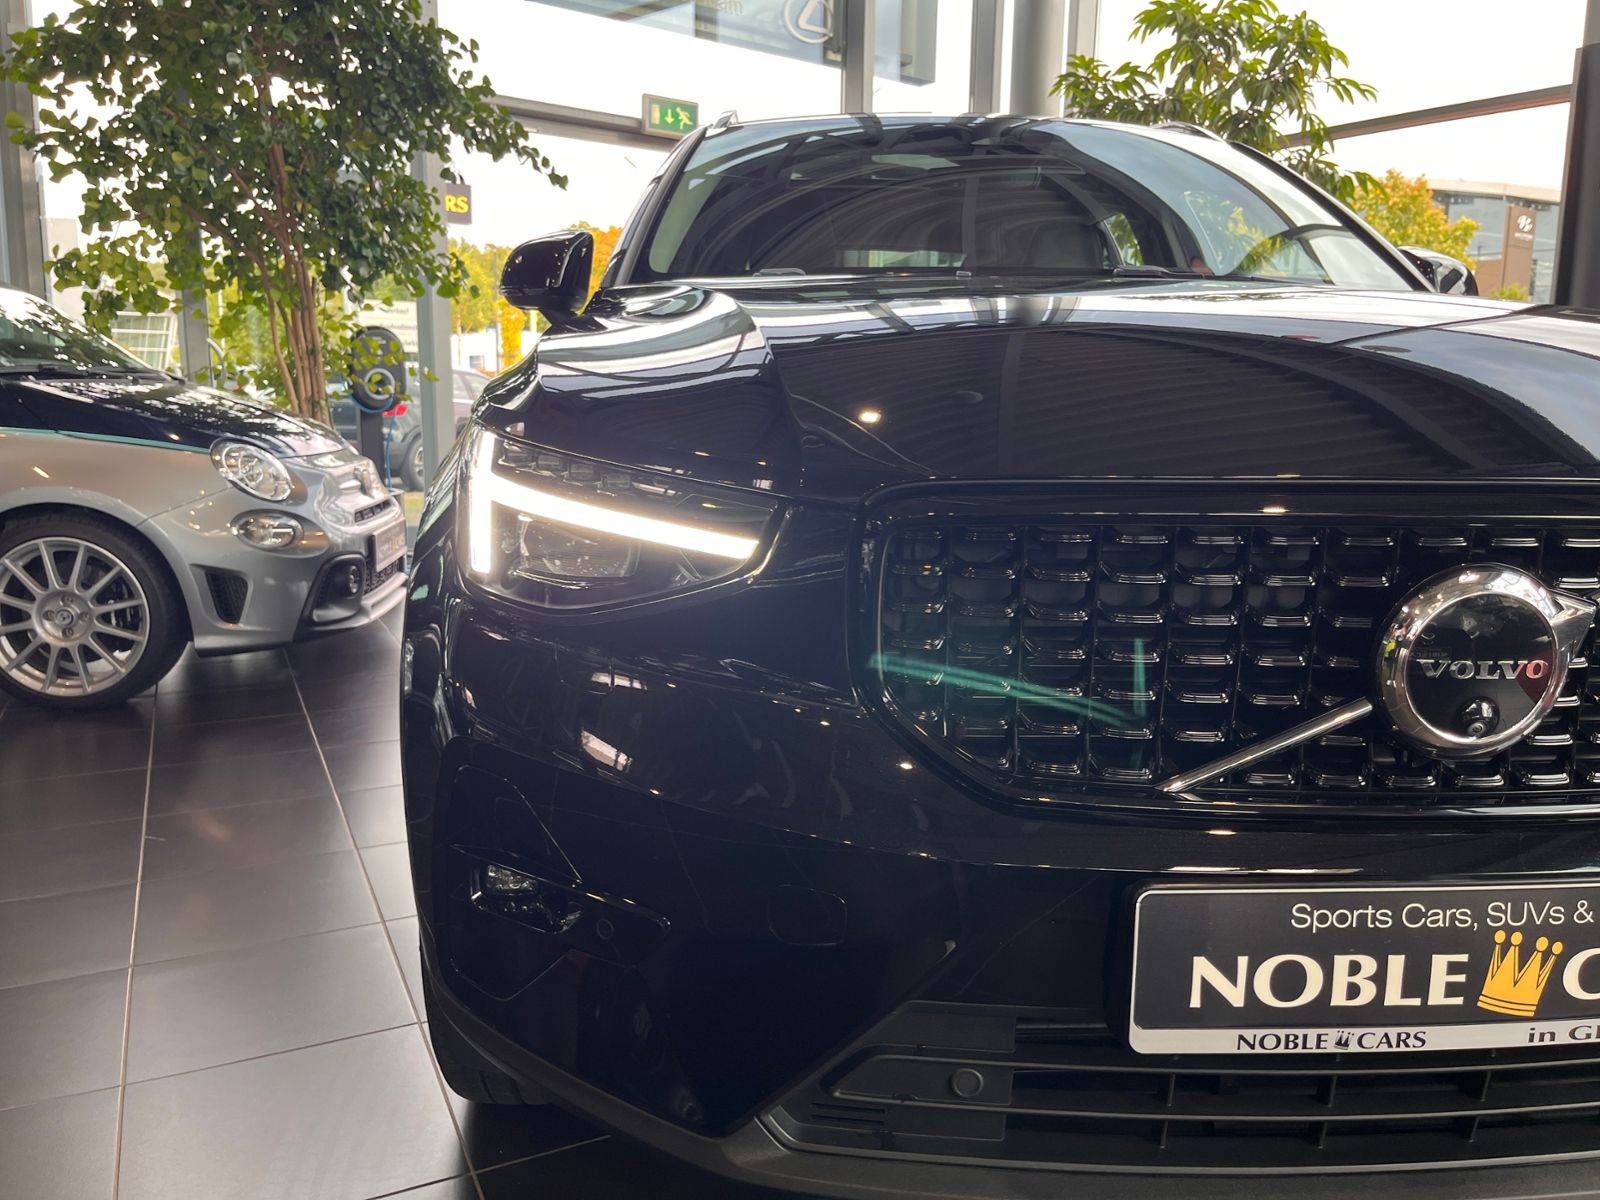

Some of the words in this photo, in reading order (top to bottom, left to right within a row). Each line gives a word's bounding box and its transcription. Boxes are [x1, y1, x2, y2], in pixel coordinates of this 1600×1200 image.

[445, 194, 469, 213] RS
[1416, 659, 1549, 680] VOLVO
[1291, 903, 1393, 934] Sports
[1402, 902, 1478, 931] Cars,
[1486, 901, 1565, 927] SUVs
[1573, 900, 1595, 924] &
[1189, 953, 1469, 1008] NOBLE
[1237, 1033, 1329, 1050] NOBLE
[1357, 1031, 1427, 1050] CARS
[1528, 1027, 1556, 1043] in
